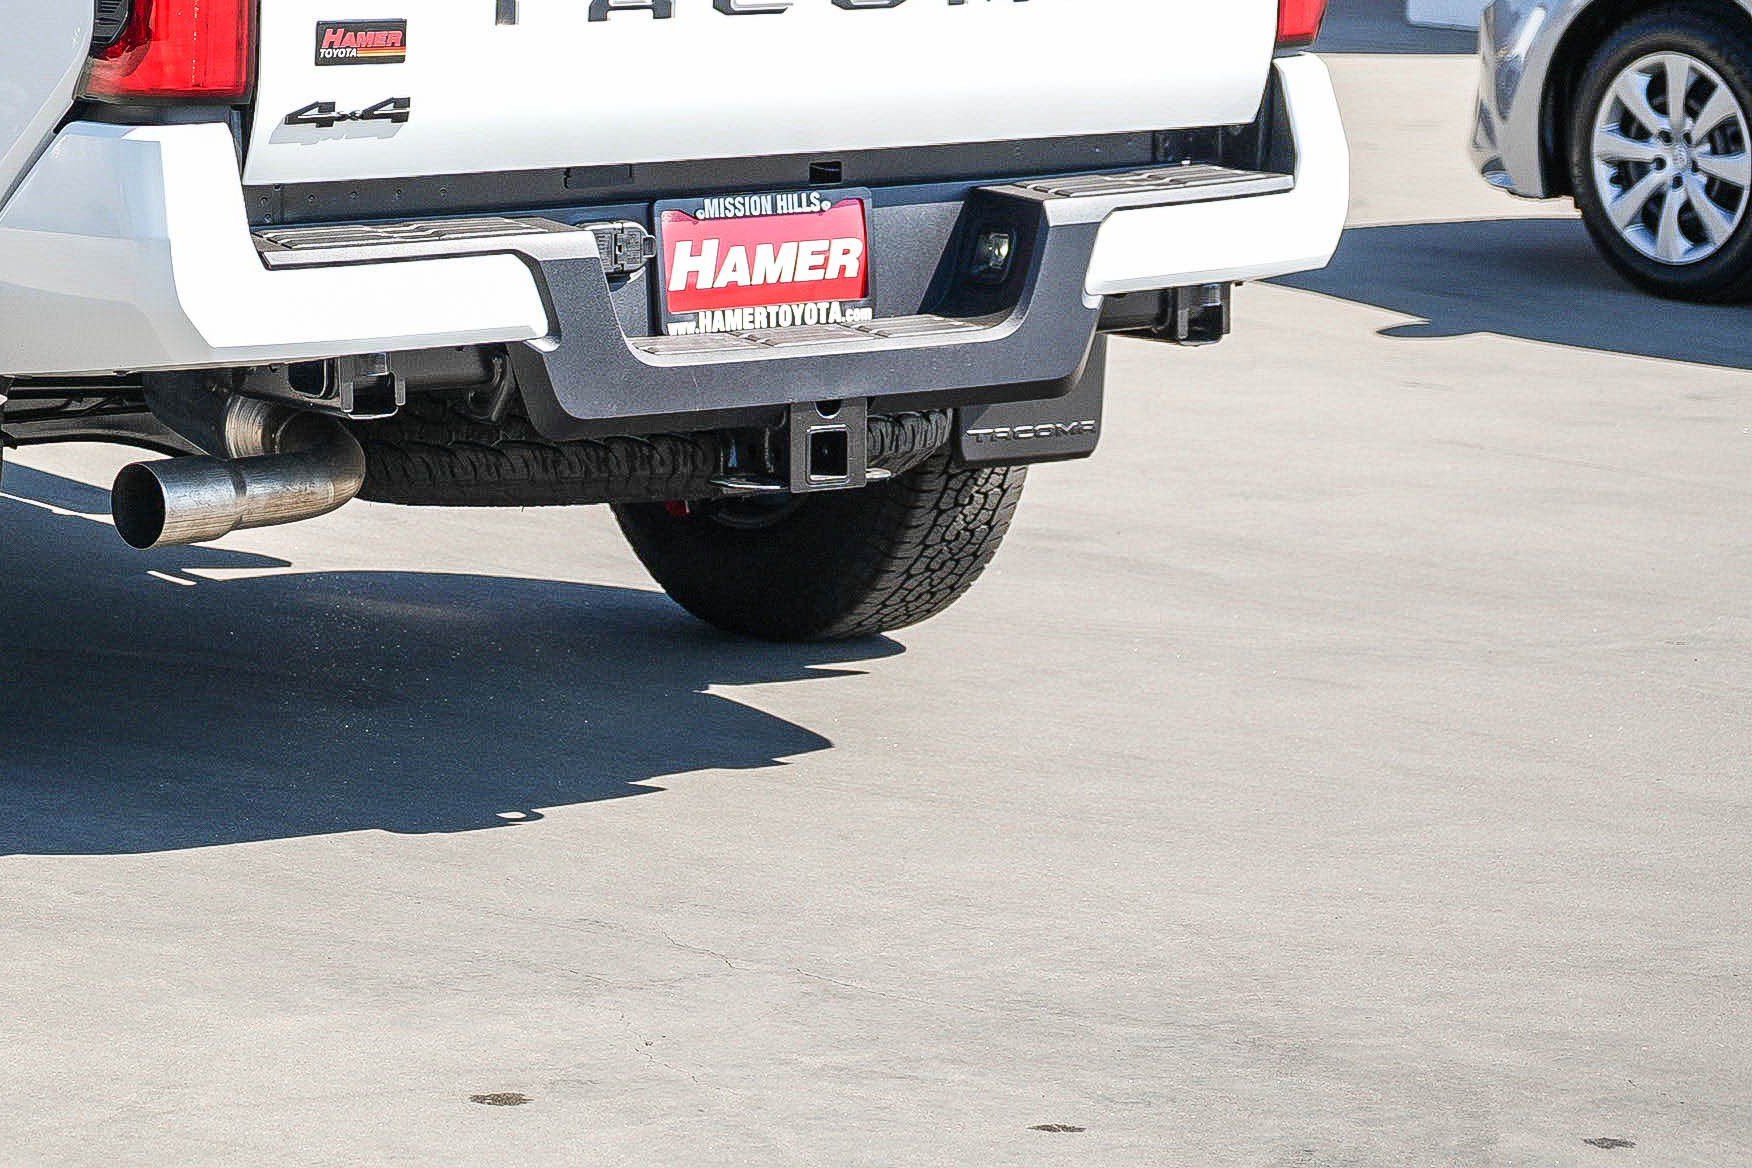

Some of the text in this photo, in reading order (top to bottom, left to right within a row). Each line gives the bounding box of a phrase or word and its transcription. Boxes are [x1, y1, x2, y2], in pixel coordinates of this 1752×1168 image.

[321, 28, 403, 49] HAMER
[319, 48, 358, 58] TOYOTA
[704, 192, 822, 220] MISSION HILLS
[668, 237, 864, 292] HAMER
